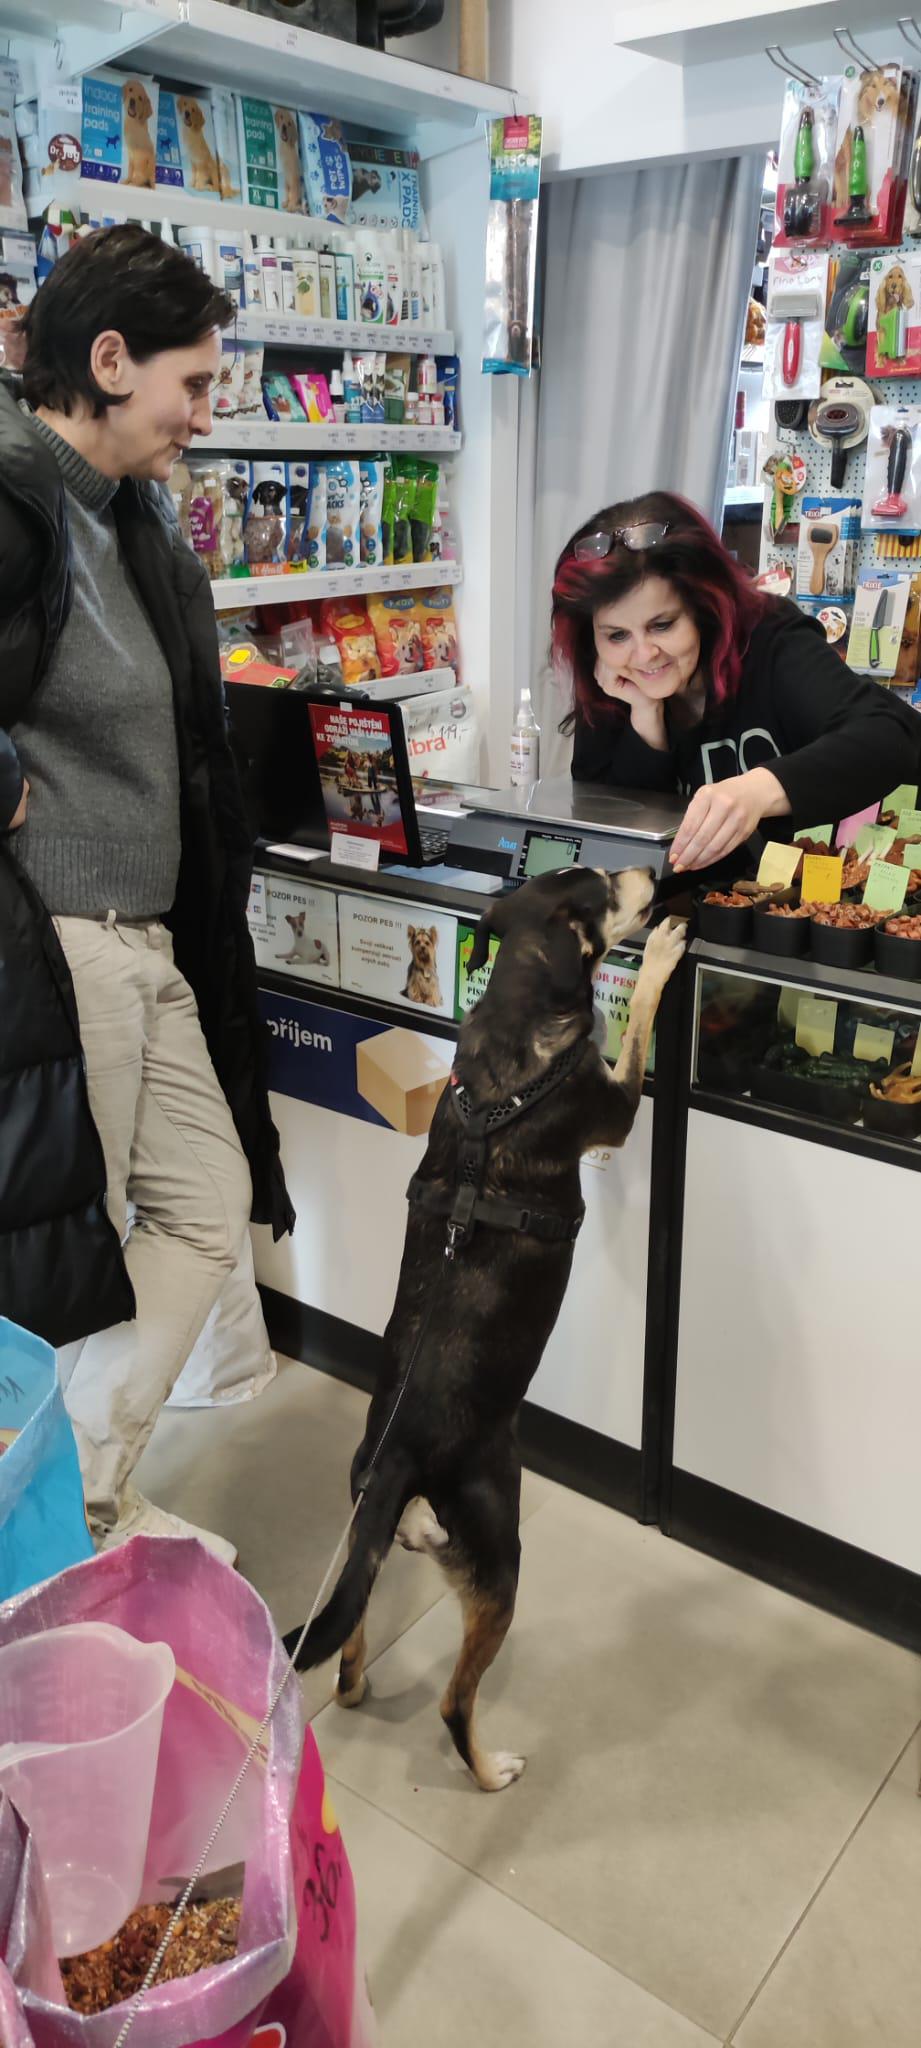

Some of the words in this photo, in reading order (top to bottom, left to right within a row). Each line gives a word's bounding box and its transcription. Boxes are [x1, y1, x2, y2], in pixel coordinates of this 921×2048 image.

[84, 86, 118, 103] indoor
[84, 102, 120, 122] training
[83, 118, 109, 131] pads
[244, 116, 273, 133] training
[246, 129, 266, 141] pads
[401, 172, 411, 182] X
[409, 174, 419, 229] TRAINING
[293, 895, 307, 906] PES
[352, 912, 378, 925] POZOR
[379, 917, 394, 928] PES
[608, 1009, 622, 1022] NA
